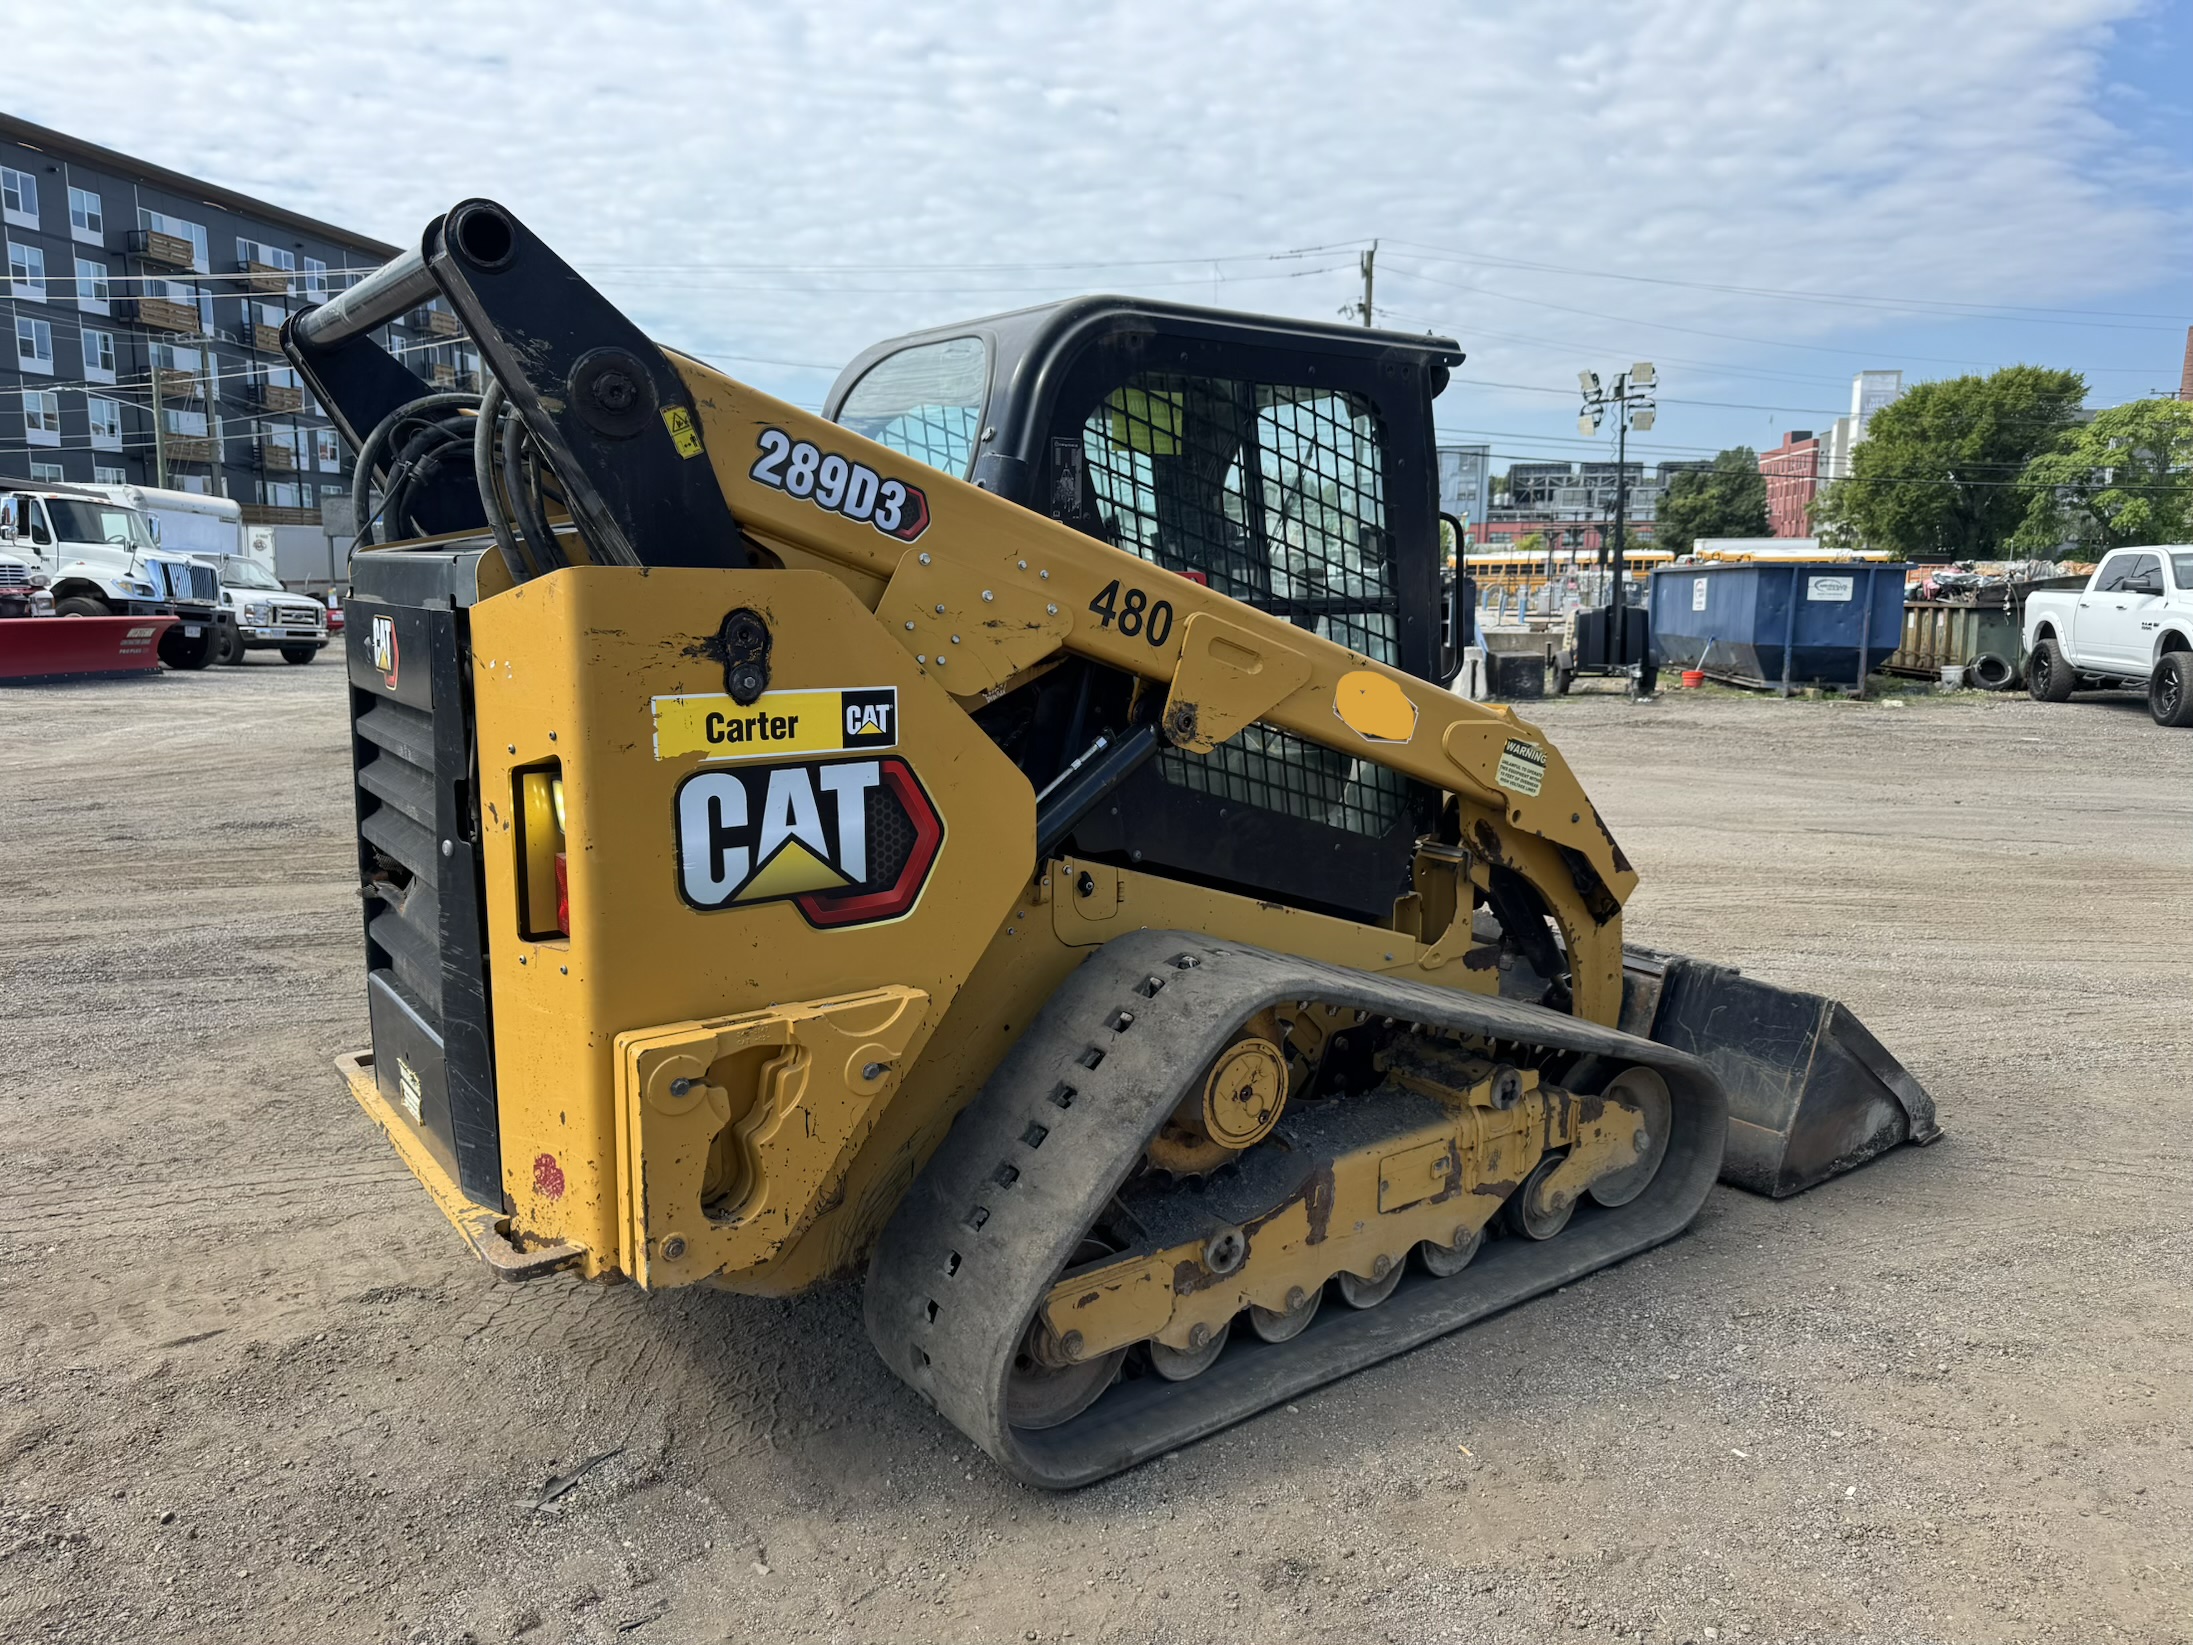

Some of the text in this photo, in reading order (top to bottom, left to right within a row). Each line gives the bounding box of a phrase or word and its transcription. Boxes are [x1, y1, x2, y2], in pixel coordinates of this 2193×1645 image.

[752, 430, 907, 531] 289D3
[1088, 579, 1173, 647] 480
[373, 617, 392, 671] CAT
[705, 703, 890, 744] Carter CAT
[1506, 741, 1547, 763] WARNING
[679, 760, 881, 905] CAT
